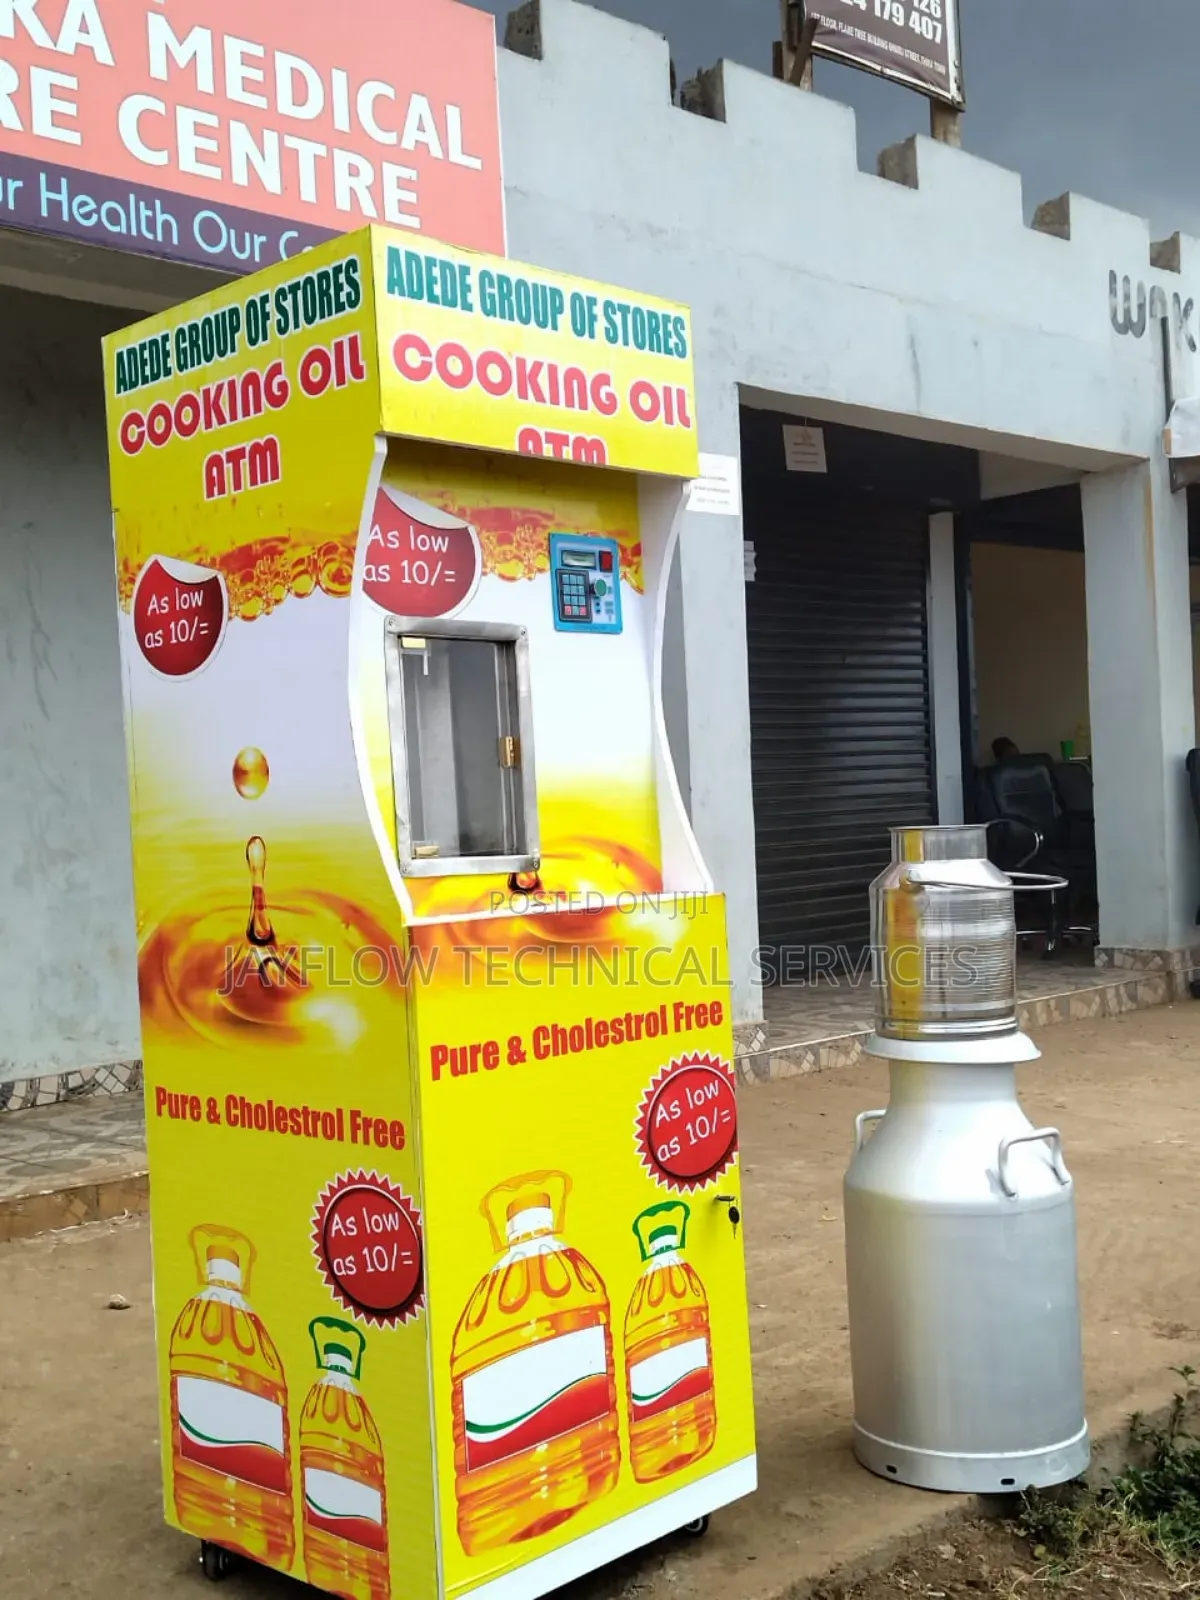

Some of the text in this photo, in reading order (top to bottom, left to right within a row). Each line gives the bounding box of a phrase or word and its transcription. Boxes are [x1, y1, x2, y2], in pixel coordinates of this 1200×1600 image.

[909, 11, 942, 44] 407
[147, 11, 482, 170] MEDICAL
[118, 93, 421, 229] CENTRE
[40, 172, 178, 246] Health
[193, 210, 267, 262] Our
[280, 231, 315, 261] C
[115, 258, 361, 395] ADEDE GROUP OF STORES
[387, 246, 687, 359] ADEDE GROUP OF STORES
[120, 334, 365, 455] COOKING OIL
[393, 333, 691, 429] COOKING OIL
[204, 436, 280, 499] ATM
[518, 427, 607, 466] ATM
[368, 524, 449, 553] As low
[147, 587, 204, 616] As low
[363, 559, 456, 586] as 10/=
[144, 616, 209, 648] as 10/=
[430, 1000, 723, 1081] Pure & Cholestrol Free
[155, 1086, 405, 1150] Pure & Cholestrol Free
[655, 1080, 719, 1128] As low
[656, 1107, 731, 1162] as 10/=
[331, 1207, 400, 1237] As low
[333, 1243, 414, 1276] as 10/=
